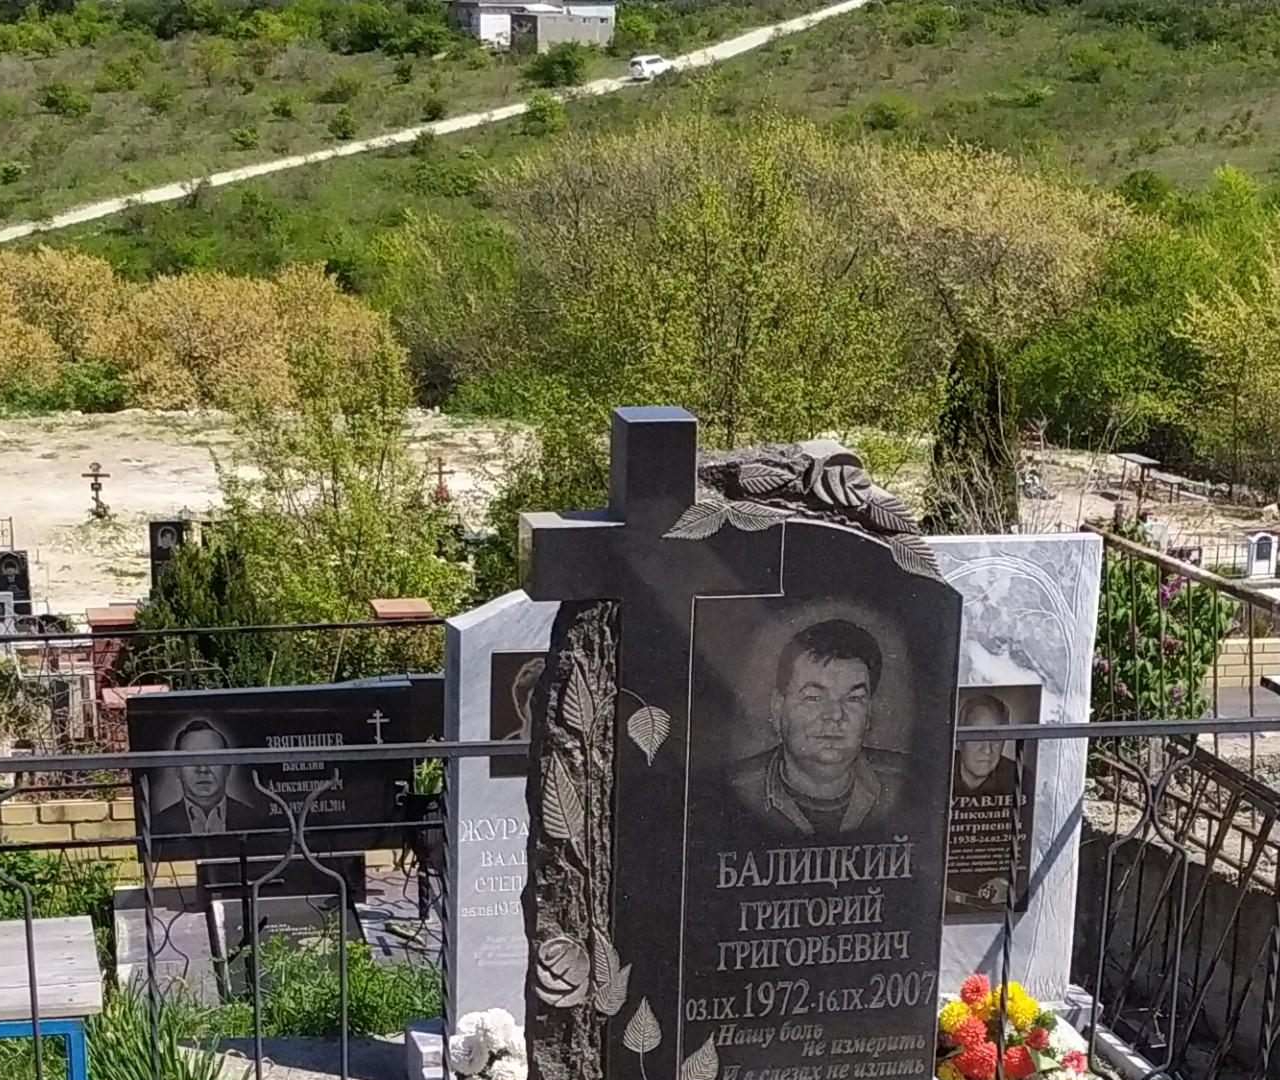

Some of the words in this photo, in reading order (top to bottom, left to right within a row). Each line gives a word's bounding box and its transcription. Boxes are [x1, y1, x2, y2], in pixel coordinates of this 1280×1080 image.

[717, 835, 915, 889] БАЛИЦКИЙ
[738, 887, 884, 932] ГРИГОРИЙ
[717, 931, 911, 971] ГРИГОРЬЕВИЧ
[716, 1023, 776, 1048] Нашу
[780, 1021, 823, 1041] боль
[802, 1040, 826, 1056] не
[831, 1034, 926, 1058] измерить
[826, 1063, 849, 1080] не
[853, 1057, 926, 1078] излить
